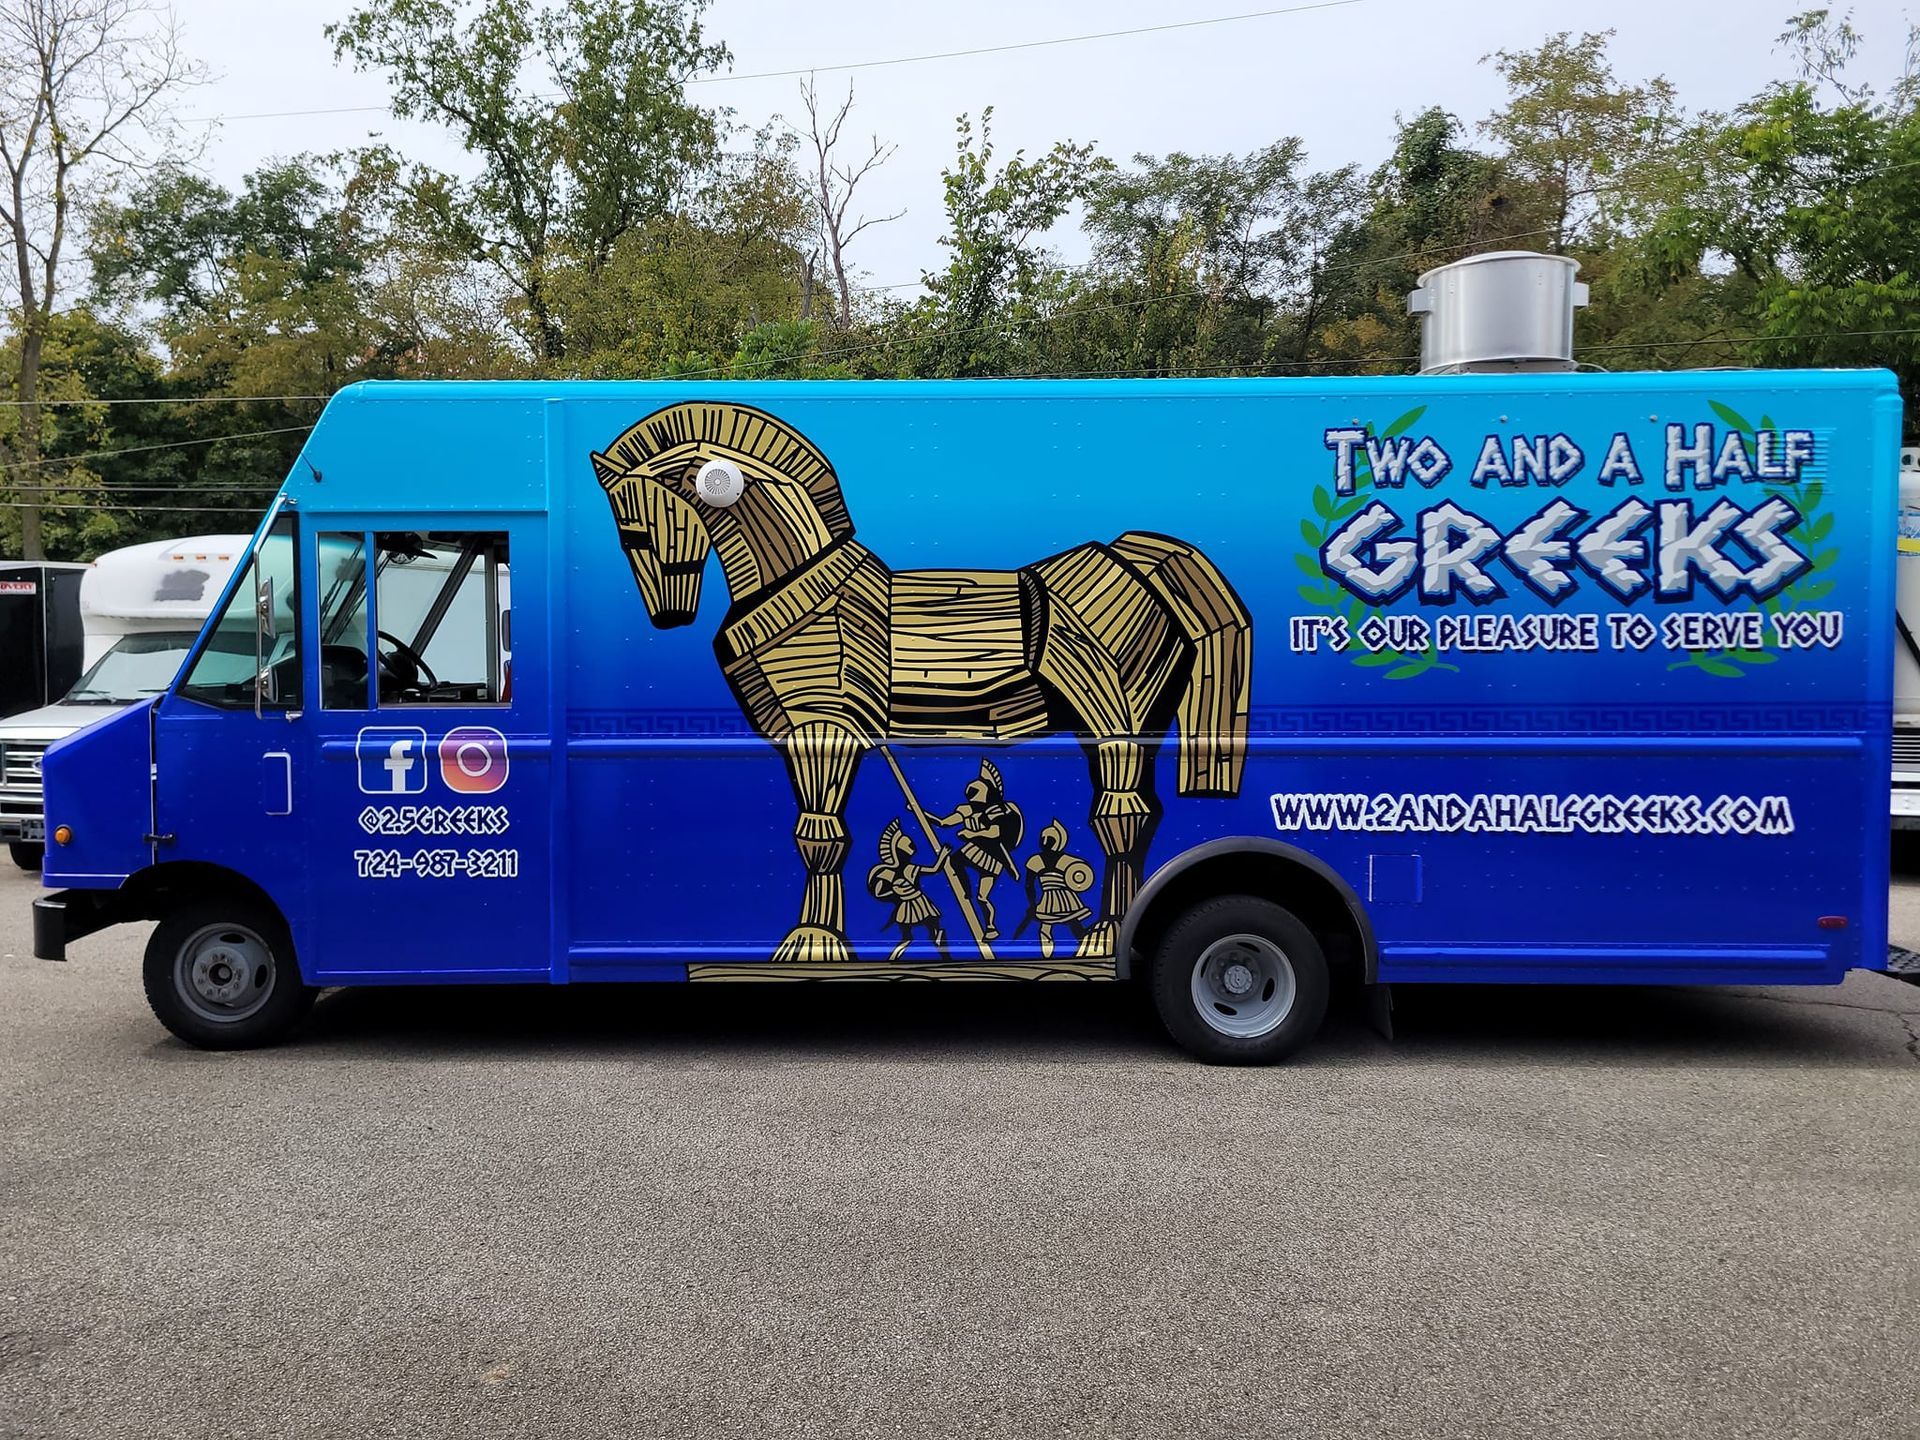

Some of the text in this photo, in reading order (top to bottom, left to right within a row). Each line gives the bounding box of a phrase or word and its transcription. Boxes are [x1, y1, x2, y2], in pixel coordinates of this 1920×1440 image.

[1470, 431, 1585, 488] AND
[1599, 431, 1644, 487] A
[1664, 422, 1814, 491] HALF
[1321, 497, 1813, 605] GREEKS
[1290, 611, 1843, 651] IT'S OUR PLEASURE TO SERVE YOU
[358, 806, 510, 834] @2.5GREEKS
[1271, 793, 1794, 834] WWW.2ANDAHALFGREEKS.COM
[354, 849, 518, 877] 724-987-3211
